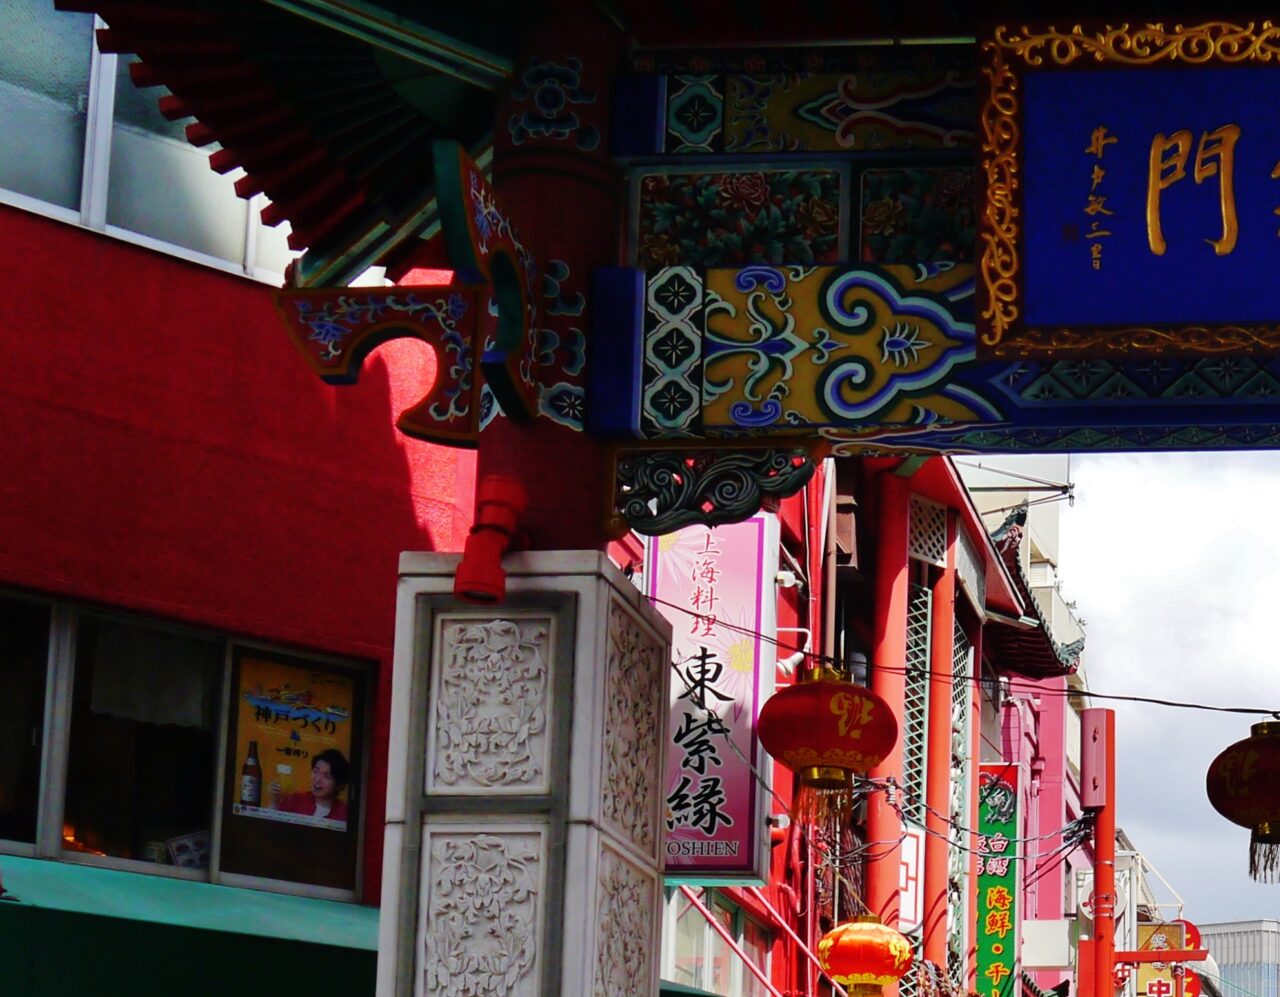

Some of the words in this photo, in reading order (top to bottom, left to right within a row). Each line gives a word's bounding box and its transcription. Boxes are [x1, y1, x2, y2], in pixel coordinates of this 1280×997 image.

[690, 533, 721, 638] 上海料理
[667, 647, 735, 835] 東紫縁
[987, 833, 1009, 876] 台湾
